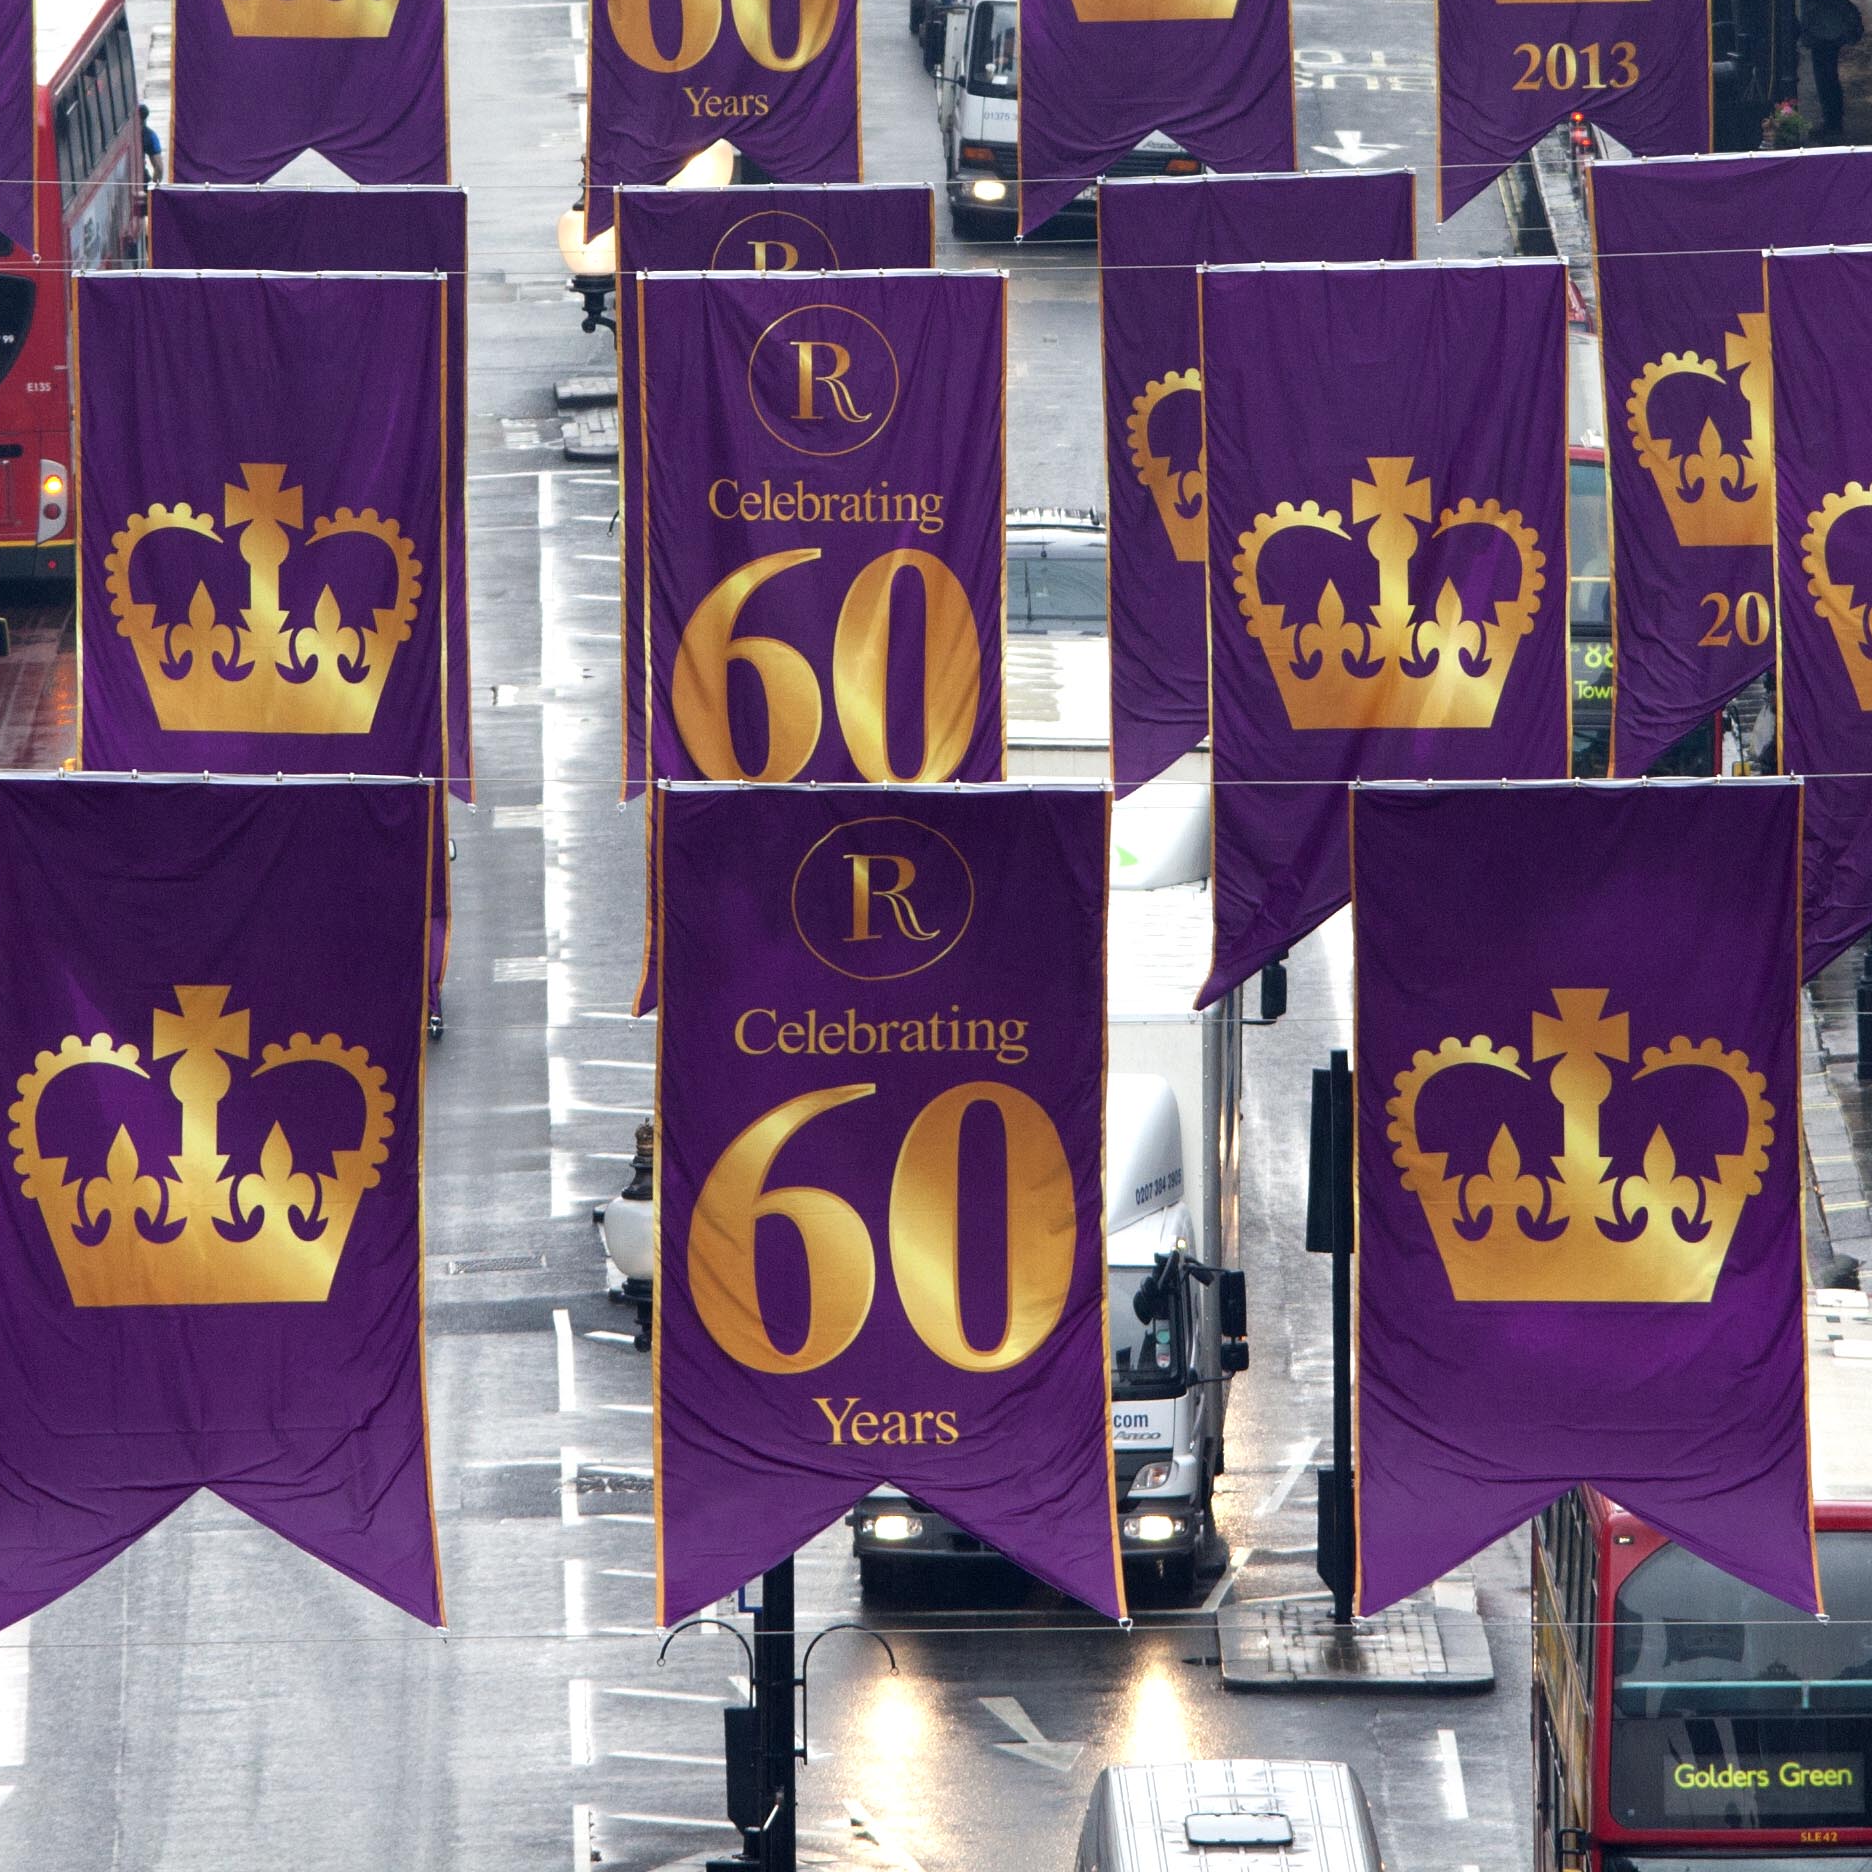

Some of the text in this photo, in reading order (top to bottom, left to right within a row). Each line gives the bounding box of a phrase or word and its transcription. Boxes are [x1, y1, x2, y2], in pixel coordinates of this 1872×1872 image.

[1514, 42, 1639, 90] 2013
[684, 87, 769, 117] Years
[790, 340, 871, 423] R
[708, 480, 943, 534] Celebrating
[1700, 592, 1769, 645] 20
[672, 548, 980, 780] 60
[842, 853, 940, 942] R
[734, 1005, 1028, 1064] Celebrating
[687, 1081, 1076, 1373] 60
[815, 1397, 959, 1445] Years
[1674, 1761, 1853, 1789] Golders Green
[1800, 1831, 1839, 1843] SLE42
